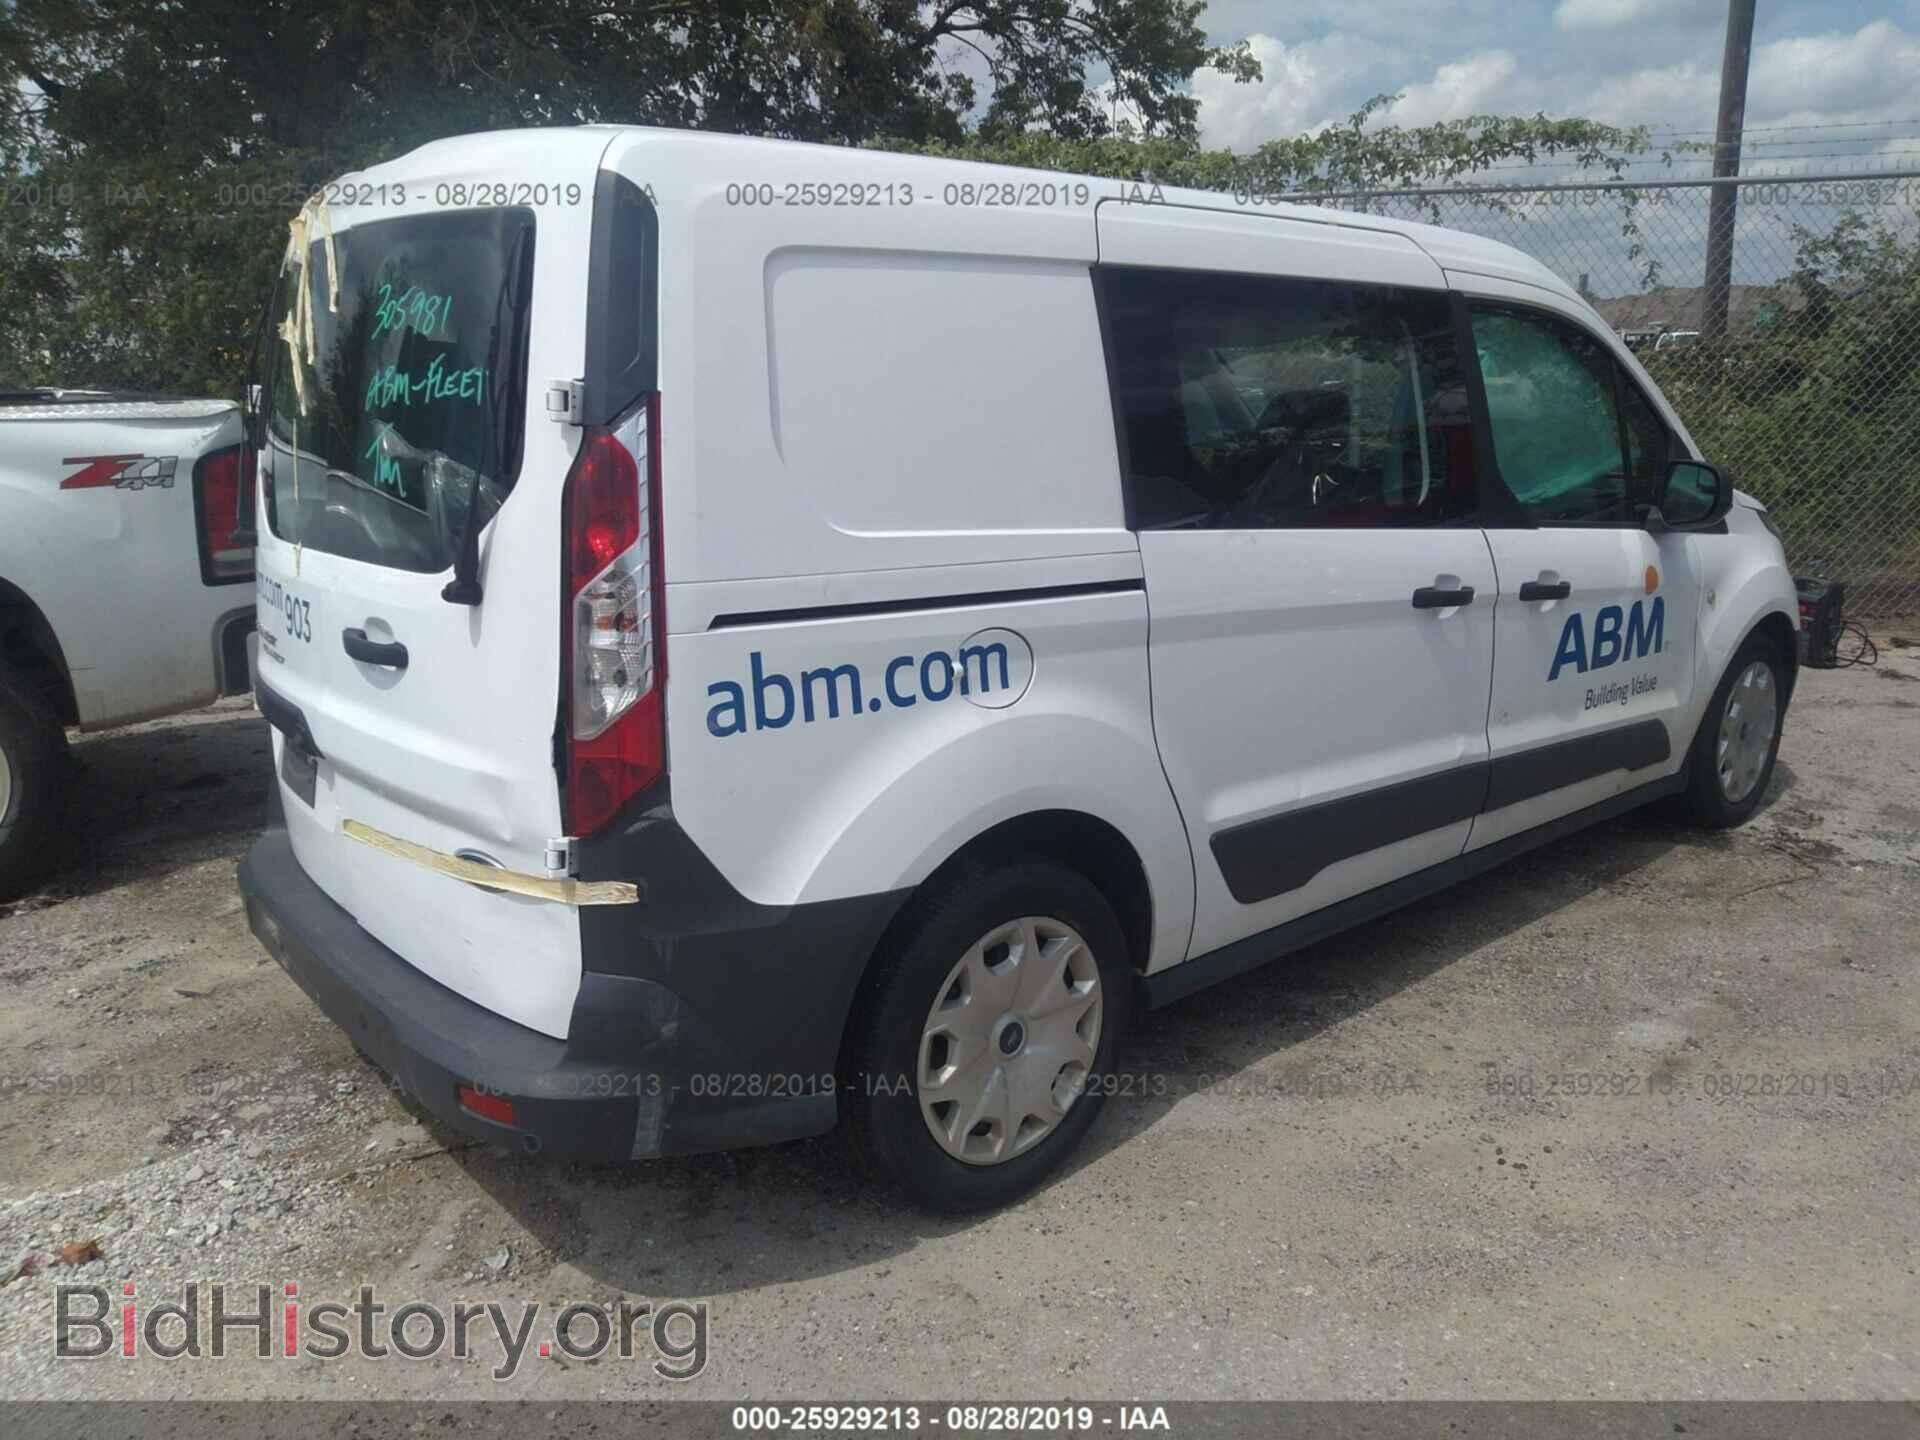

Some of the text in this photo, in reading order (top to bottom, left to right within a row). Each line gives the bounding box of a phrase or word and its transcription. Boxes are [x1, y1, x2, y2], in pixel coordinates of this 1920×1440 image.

[285, 593, 312, 644] 903
[1546, 595, 1665, 683] ABM
[705, 641, 1011, 738] abm.com
[1584, 675, 1658, 711] Building Value
